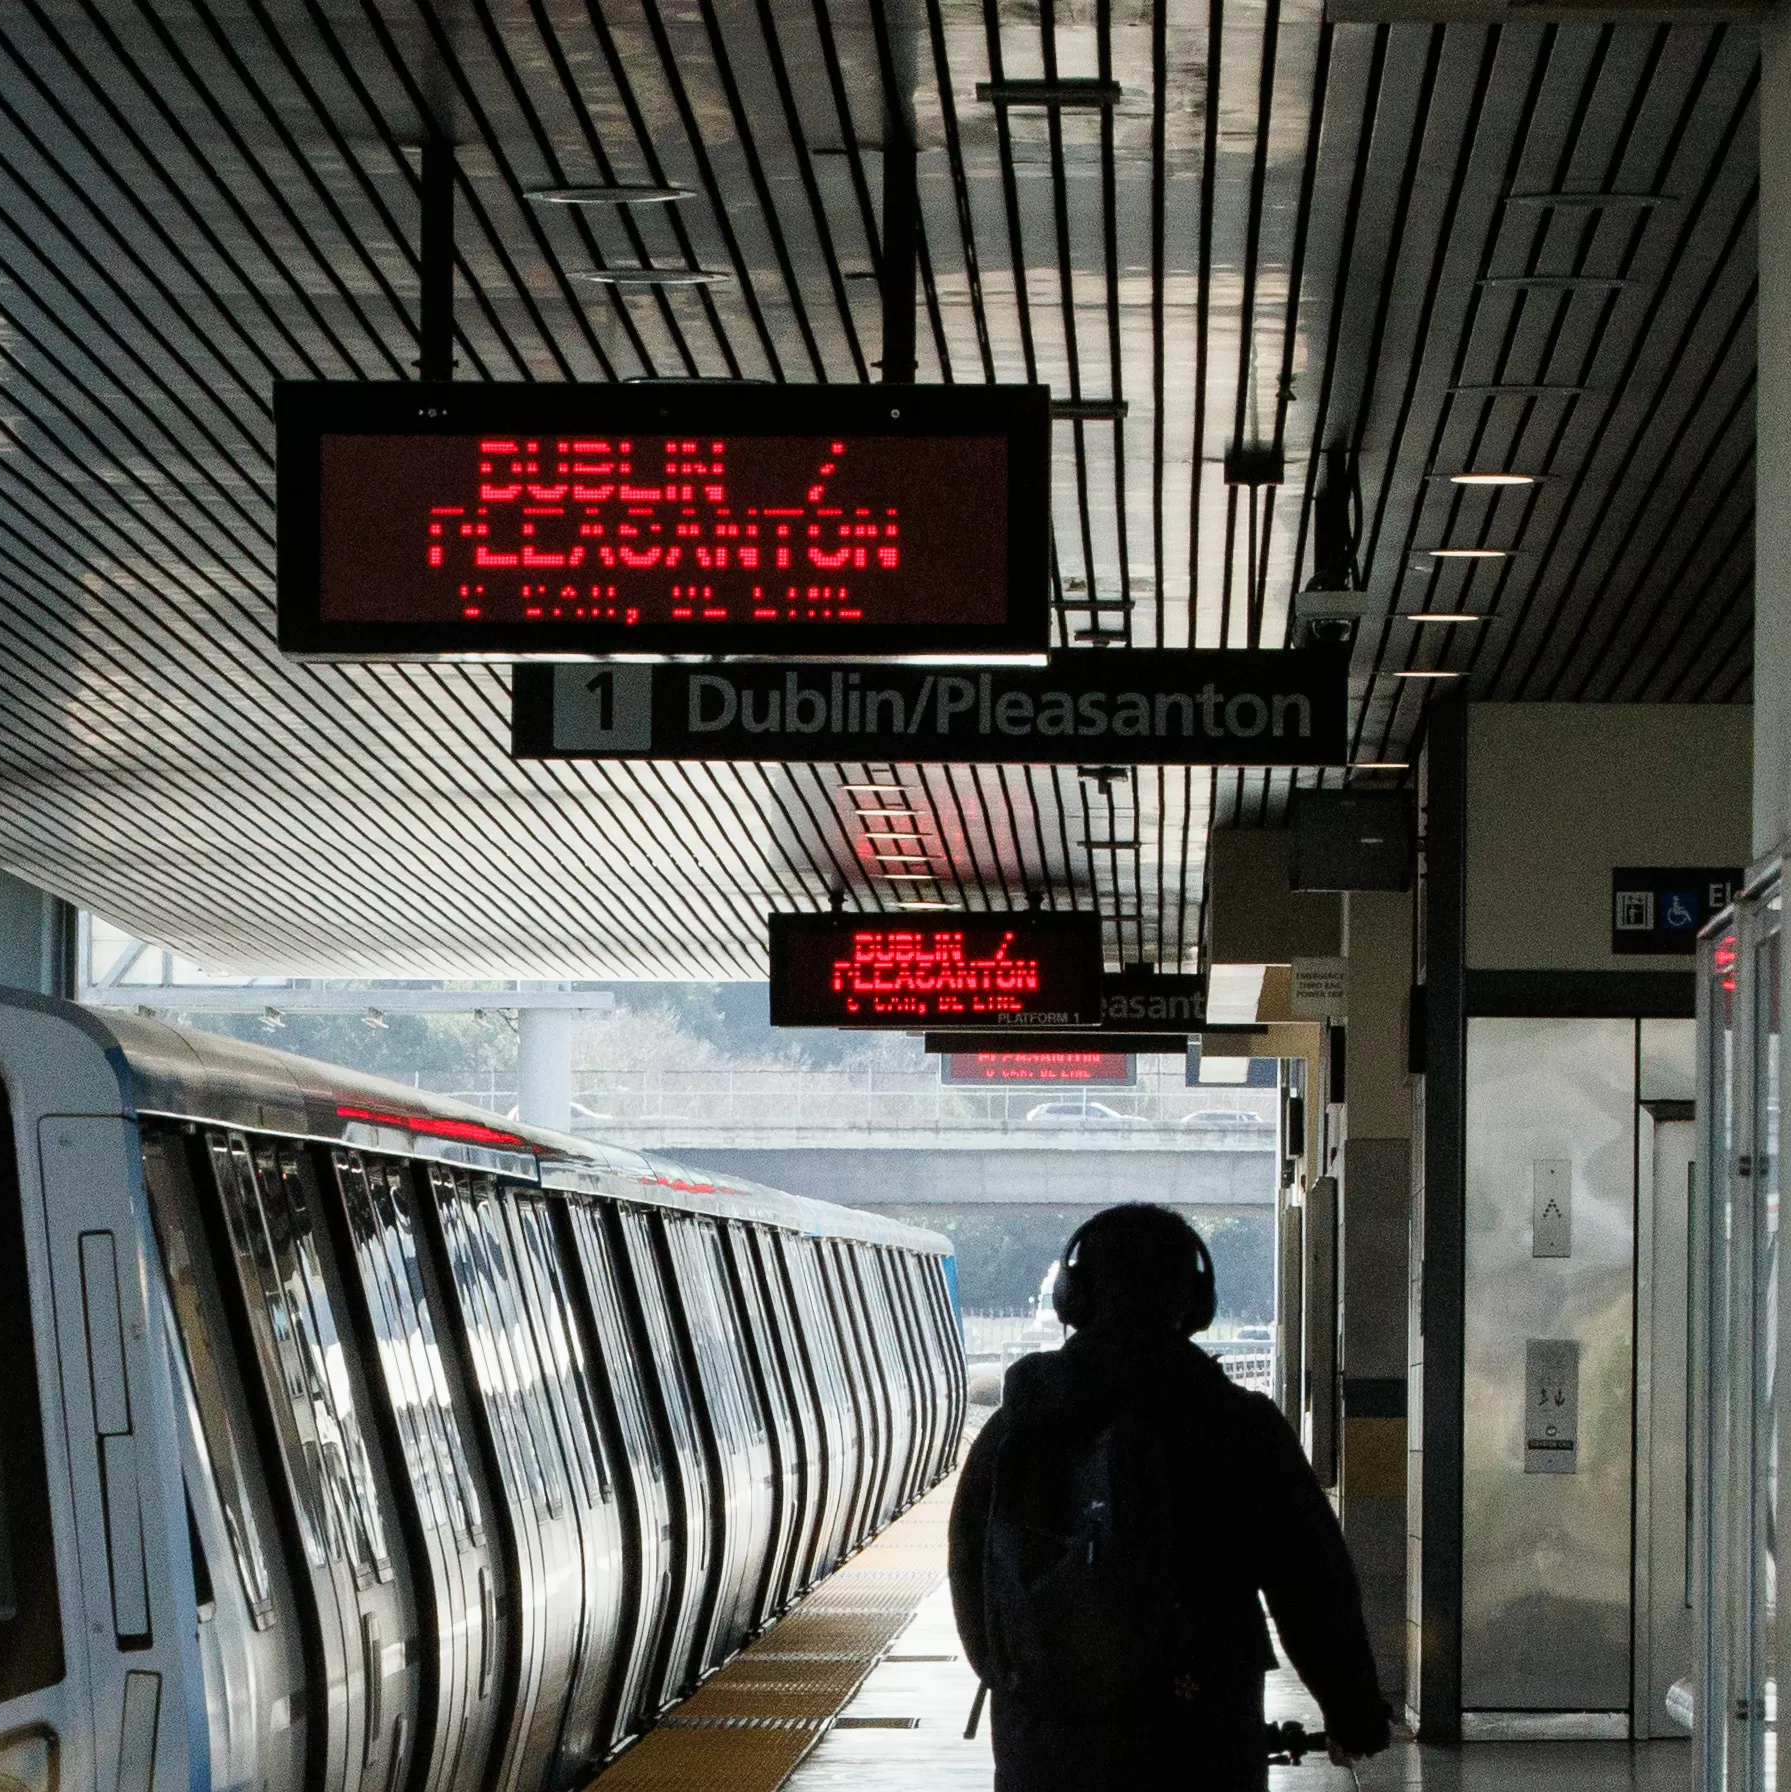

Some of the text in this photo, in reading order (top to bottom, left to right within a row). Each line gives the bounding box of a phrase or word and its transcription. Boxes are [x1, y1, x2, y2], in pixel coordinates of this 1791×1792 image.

[480, 441, 726, 501] DUBLIN
[585, 671, 1312, 738] 1 Dublin/Pleasanton
[854, 932, 964, 961] DUBLIN
[997, 1012, 1080, 1024] PLATFORM 1
